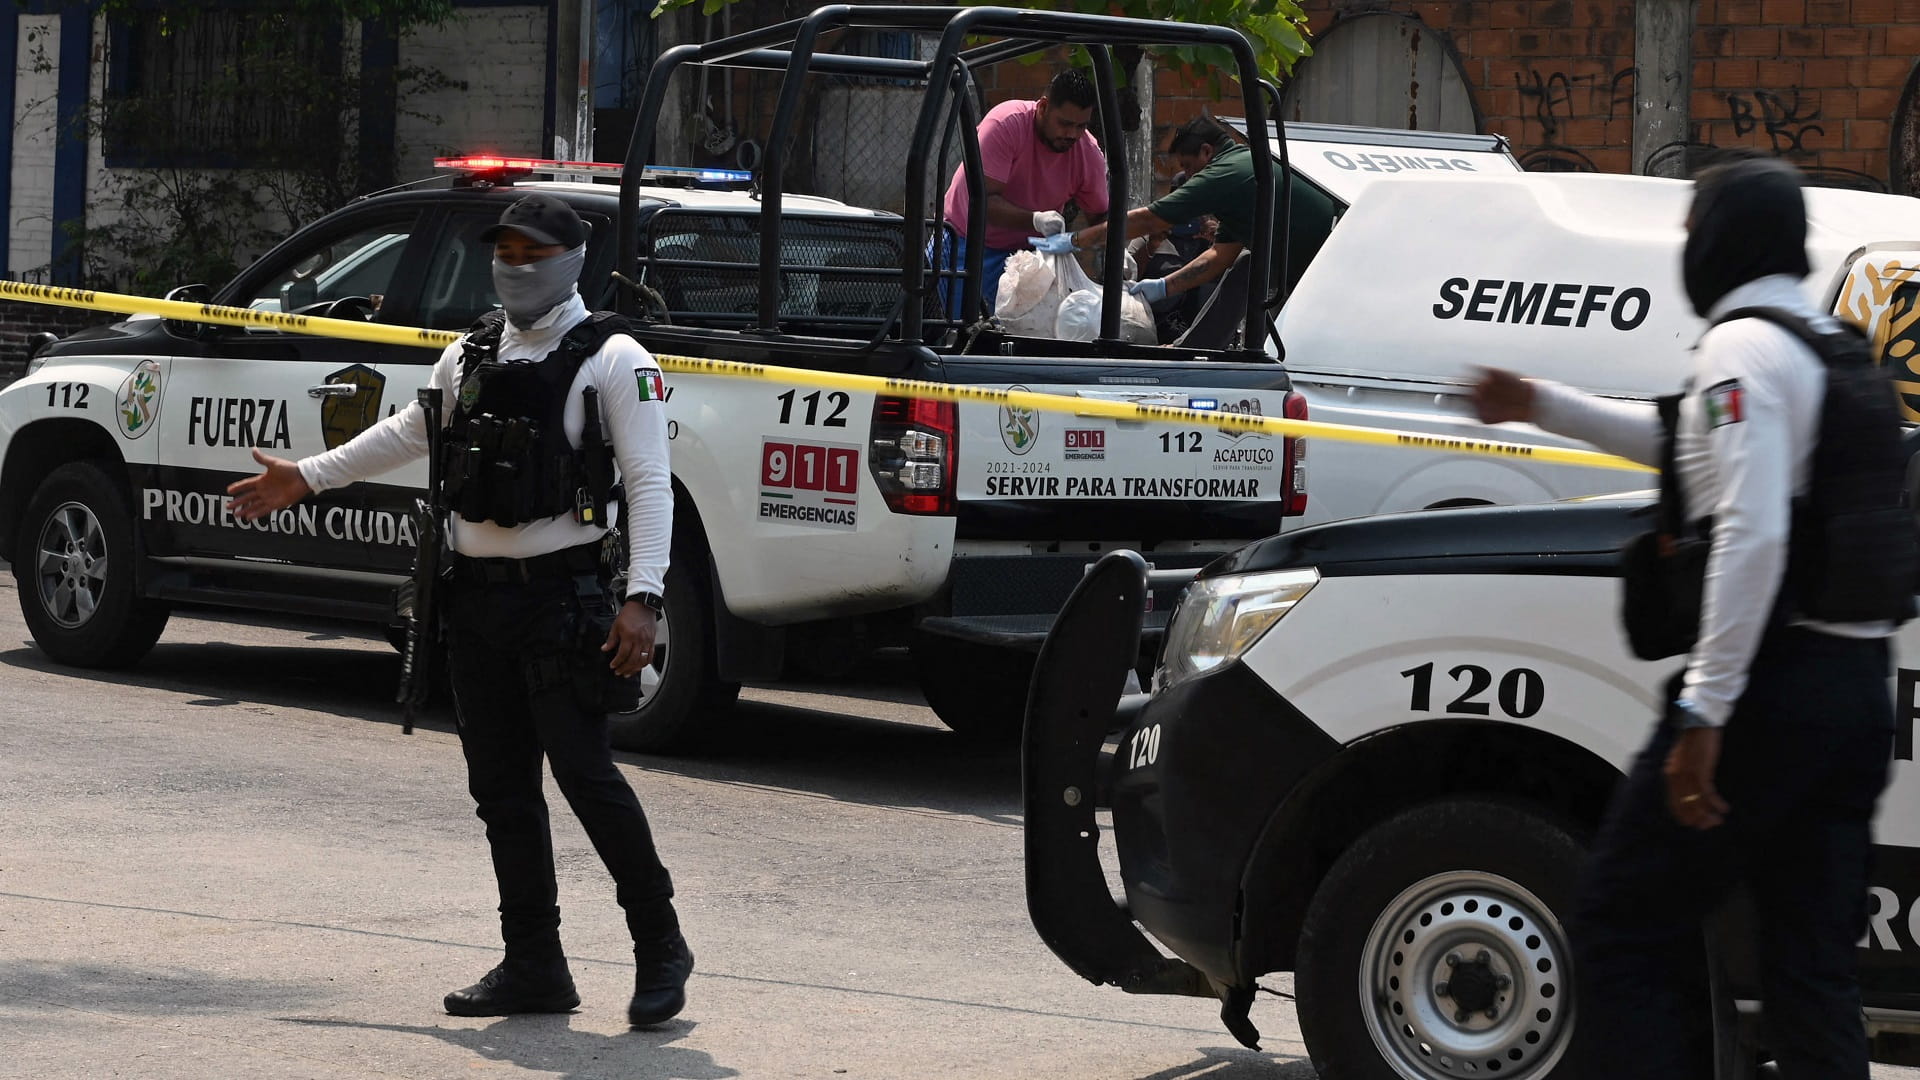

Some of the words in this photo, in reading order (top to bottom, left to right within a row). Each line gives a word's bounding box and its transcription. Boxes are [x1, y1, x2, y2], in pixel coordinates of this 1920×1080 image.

[1432, 277, 1651, 331] SEMEFO
[45, 382, 90, 409] 112
[776, 389, 851, 428] 112
[188, 396, 291, 449] FUERZA
[1068, 432, 1101, 446] 911
[1159, 431, 1203, 453] 112
[767, 449, 850, 485] 911
[986, 462, 1051, 473] 2021-2024
[1213, 448, 1274, 464] ACAPULCO
[986, 476, 1059, 496] SERVIR
[1065, 477, 1117, 496] PARA
[1122, 477, 1259, 498] TRANSFORMAR
[759, 502, 856, 526] EMERGENCIAS
[1401, 661, 1545, 719] 120
[1129, 723, 1161, 770] 120
